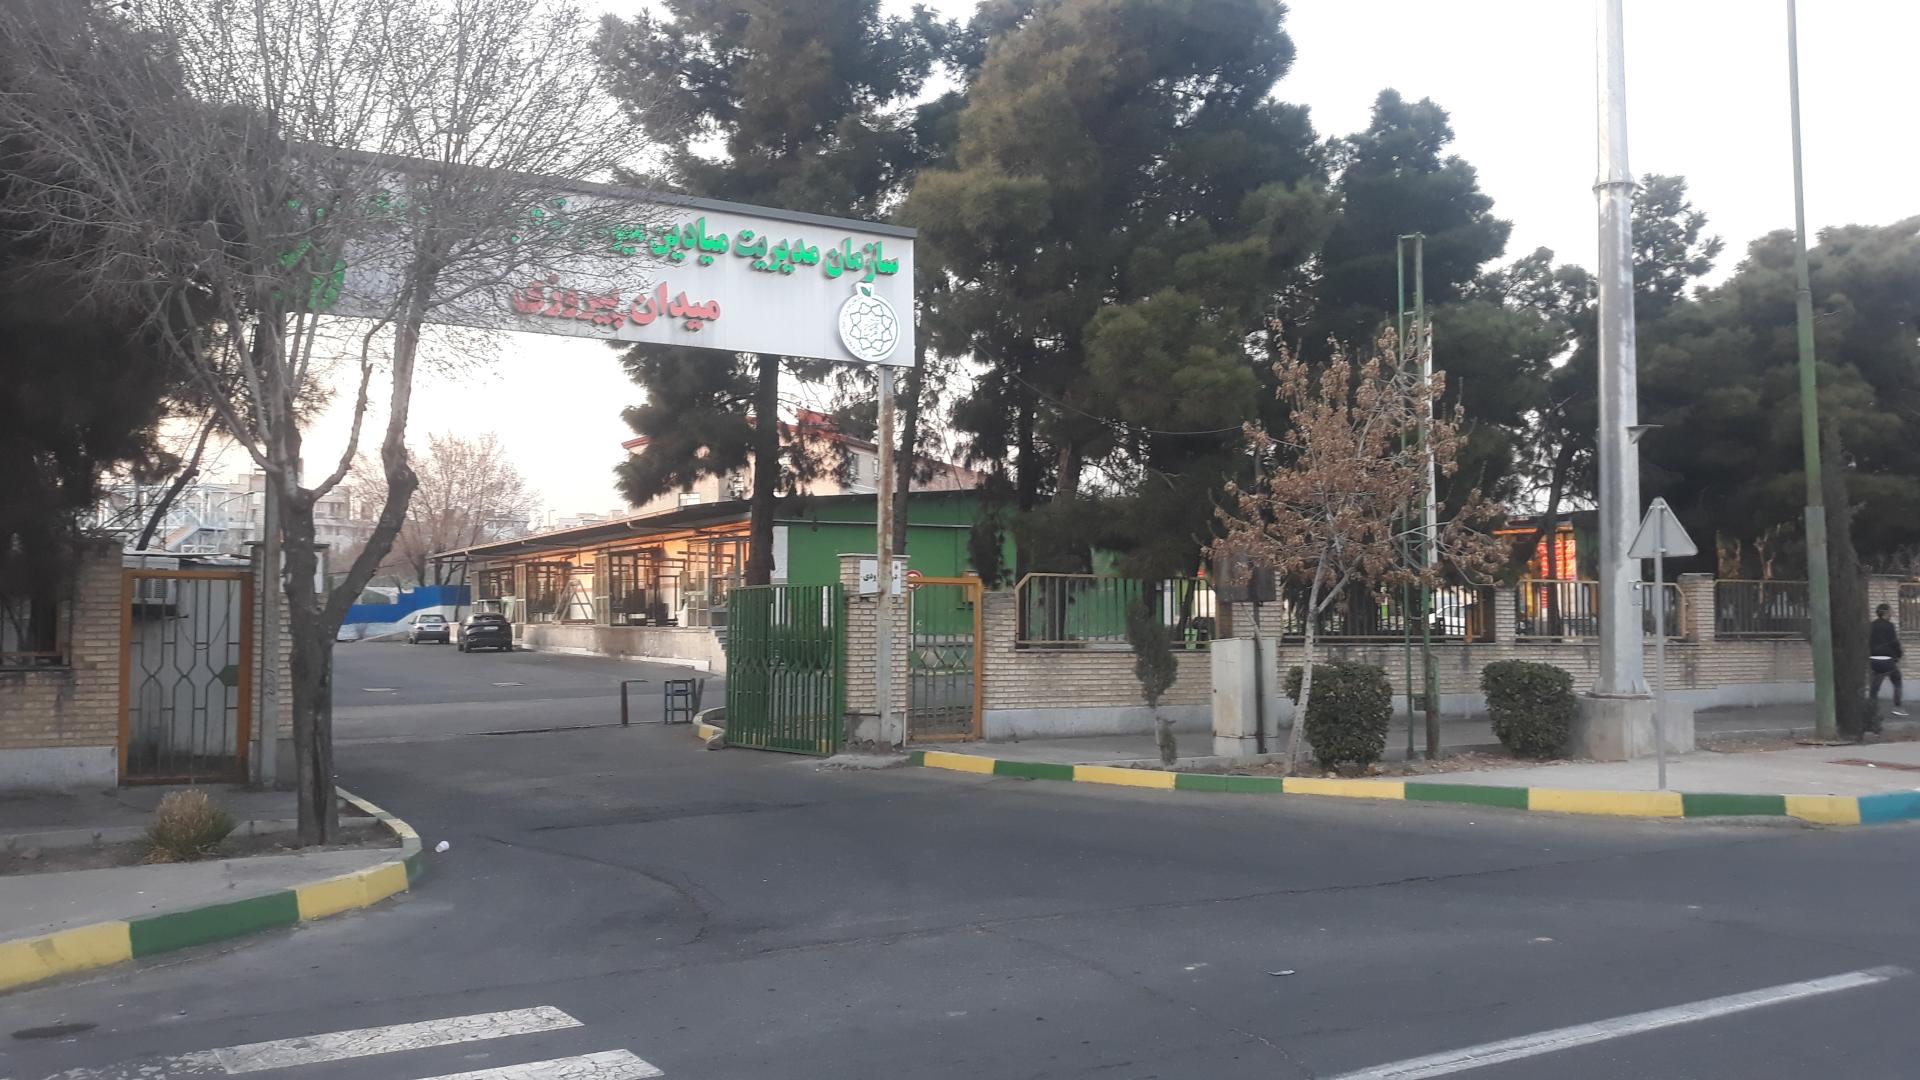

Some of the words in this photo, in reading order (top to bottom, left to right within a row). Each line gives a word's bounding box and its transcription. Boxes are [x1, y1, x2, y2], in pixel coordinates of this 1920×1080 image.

[650, 217, 731, 264] میادین
[733, 228, 820, 275] مدیریت
[824, 237, 899, 282] سازمان
[631, 283, 721, 331] میدان
